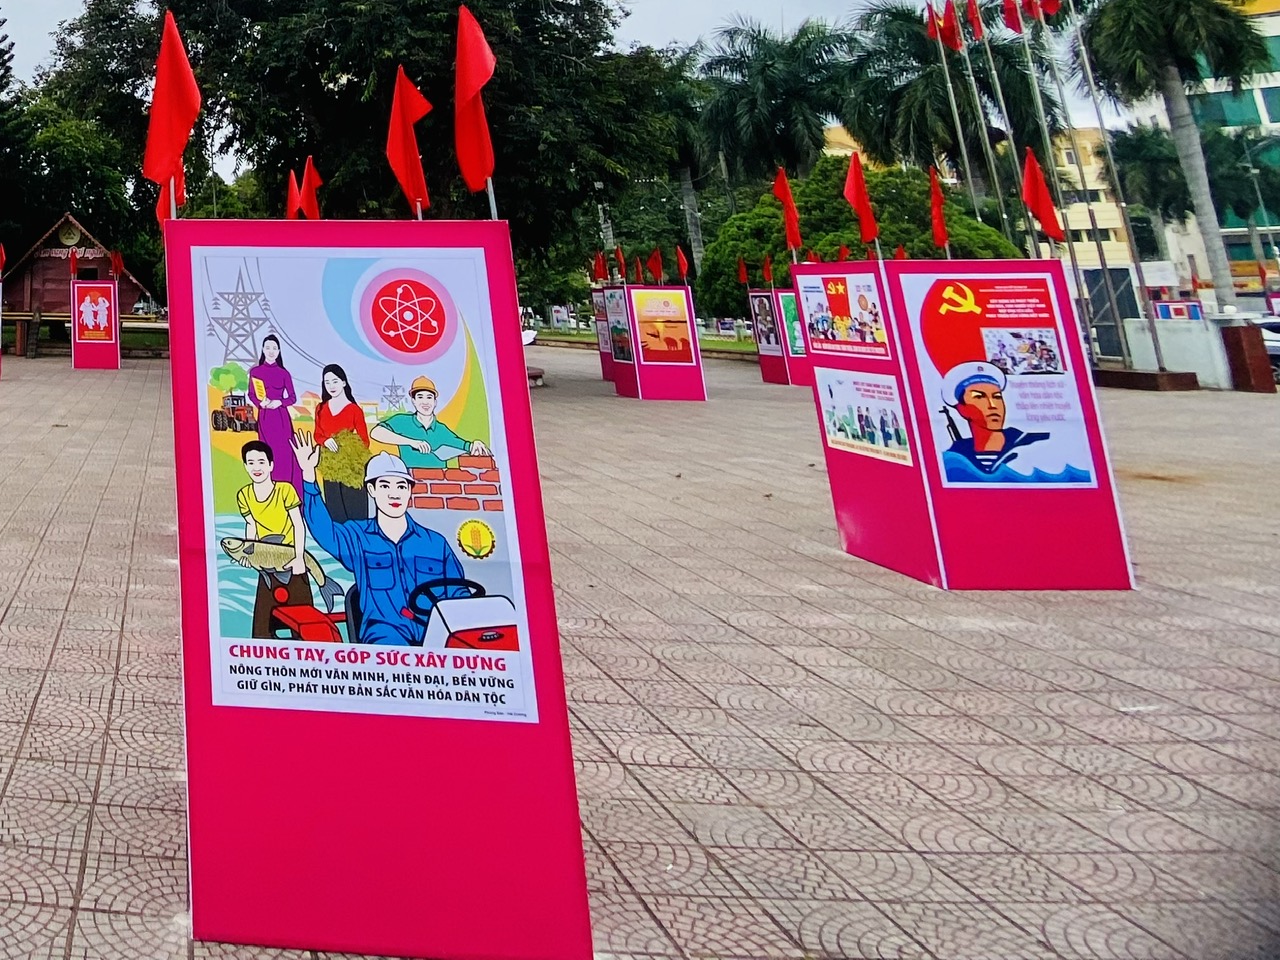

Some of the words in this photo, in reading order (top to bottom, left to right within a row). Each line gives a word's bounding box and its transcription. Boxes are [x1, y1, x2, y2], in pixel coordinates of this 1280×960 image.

[229, 644, 290, 660] CHUNG
[294, 647, 330, 664] TAY,
[334, 647, 371, 665] GÓP
[376, 650, 411, 667] SỨC
[414, 651, 448, 669] XÂY
[452, 655, 507, 674] DỰNG
[229, 663, 262, 676] NÔNG
[264, 665, 297, 678] THÔN
[300, 666, 322, 679] MỚI
[325, 668, 349, 680] VĂN
[352, 671, 389, 683] MINH,
[392, 671, 421, 686] HIỆN
[424, 674, 449, 688] ĐẠI,
[452, 673, 477, 687] BỀN
[478, 675, 515, 689] VỮNG
[237, 678, 259, 690] GIỮ
[260, 679, 286, 693] GÌN,
[288, 681, 319, 694] PHÁT
[321, 684, 345, 695] HUY
[348, 683, 373, 697] BẢN
[376, 685, 399, 698] SẮC
[399, 687, 425, 700] VĂN
[427, 688, 453, 702] HÓA
[455, 690, 481, 703] DÂN
[483, 692, 507, 707] TỘC
